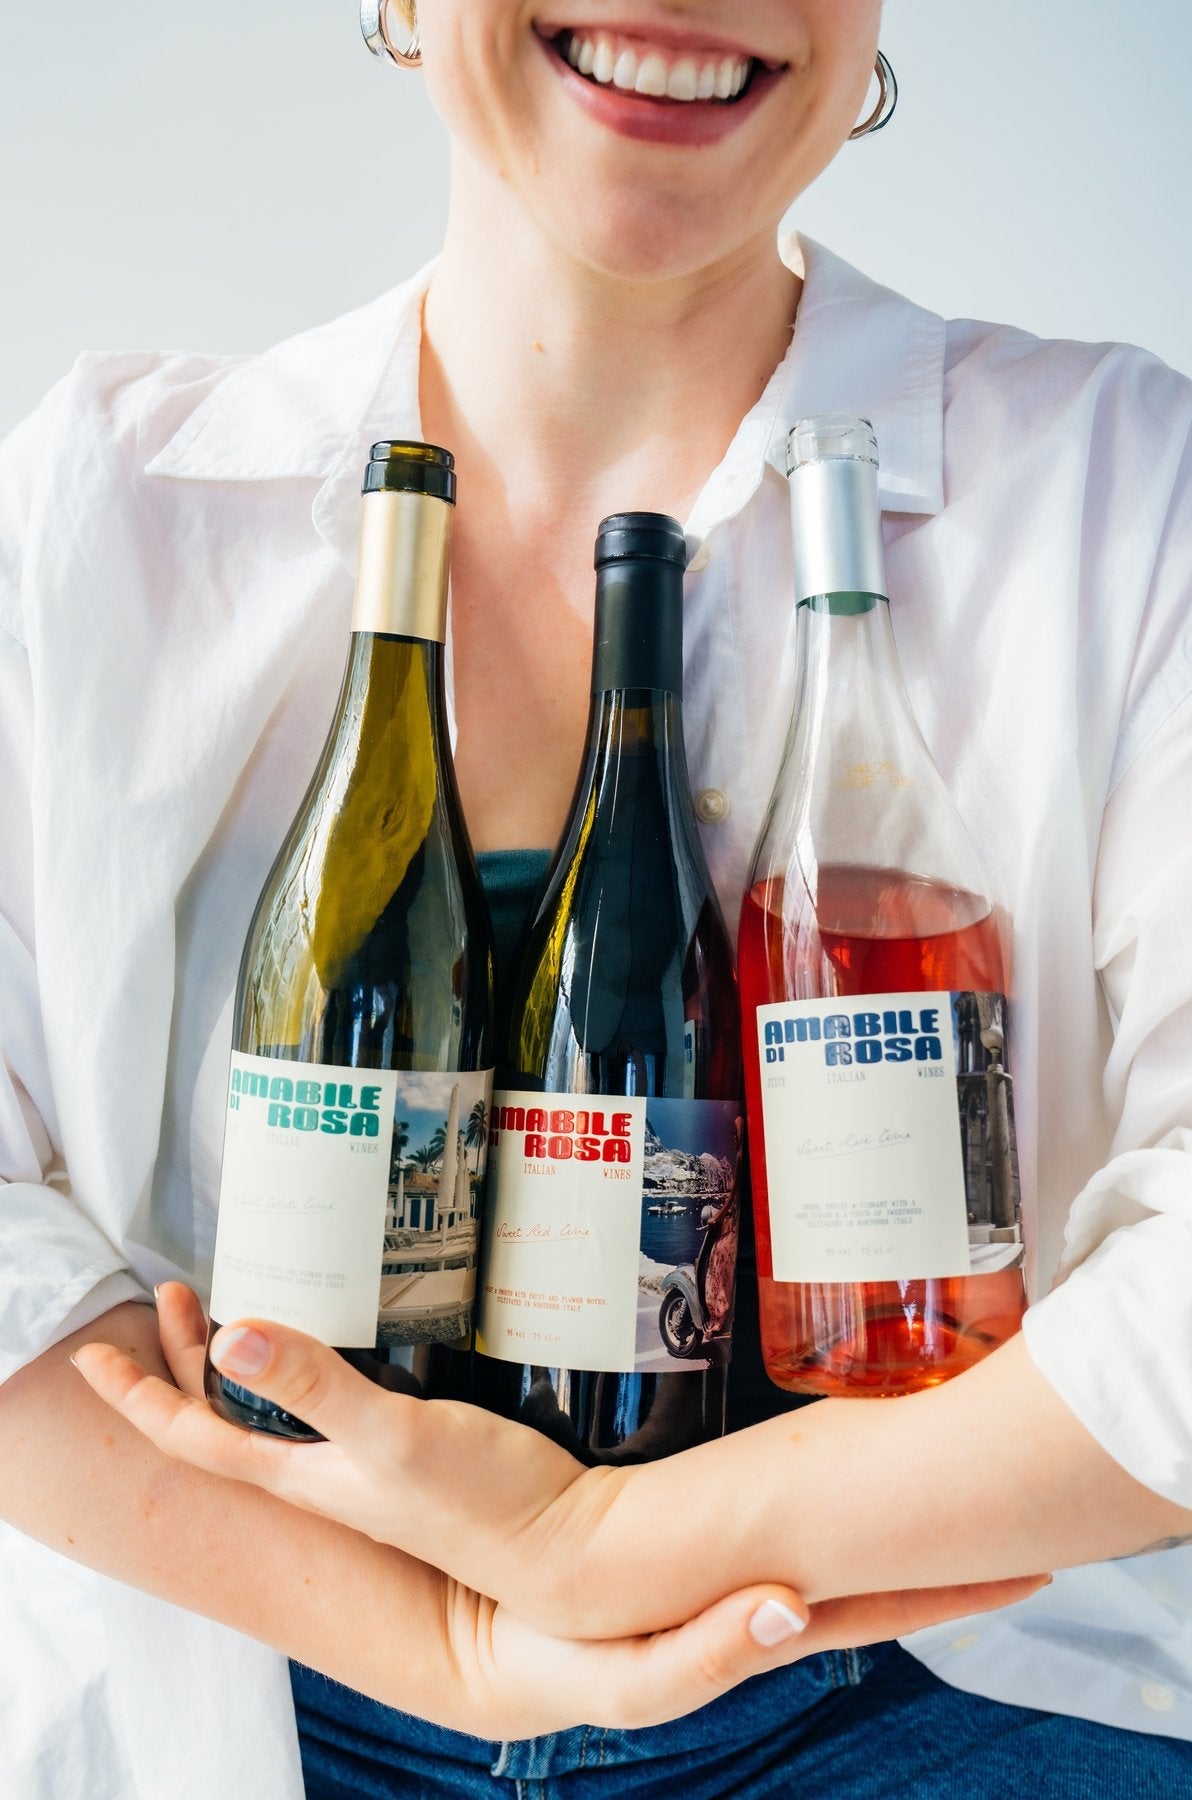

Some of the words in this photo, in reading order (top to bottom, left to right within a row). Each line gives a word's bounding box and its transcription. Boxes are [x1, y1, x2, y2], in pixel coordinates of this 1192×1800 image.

[764, 1008, 940, 1046] AMABILE
[766, 1047, 785, 1063] DI
[825, 1036, 943, 1067] ROSA
[827, 1071, 866, 1085] ITALIAN
[917, 1066, 945, 1078] WINES
[231, 1067, 383, 1111] AMABILE
[229, 1093, 240, 1111] DI
[267, 1103, 380, 1138] ROSA
[350, 1142, 379, 1154] WINES
[524, 1134, 631, 1163] ROSA
[523, 1163, 556, 1175] ITALIAN
[603, 1168, 631, 1180] WINES
[496, 1223, 522, 1238] Sweet
[528, 1293, 545, 1301] FRUIT
[561, 1296, 583, 1304] FLOWER
[563, 1304, 581, 1313] ITALY
[515, 1330, 526, 1339] vol
[532, 1332, 541, 1341] 75
